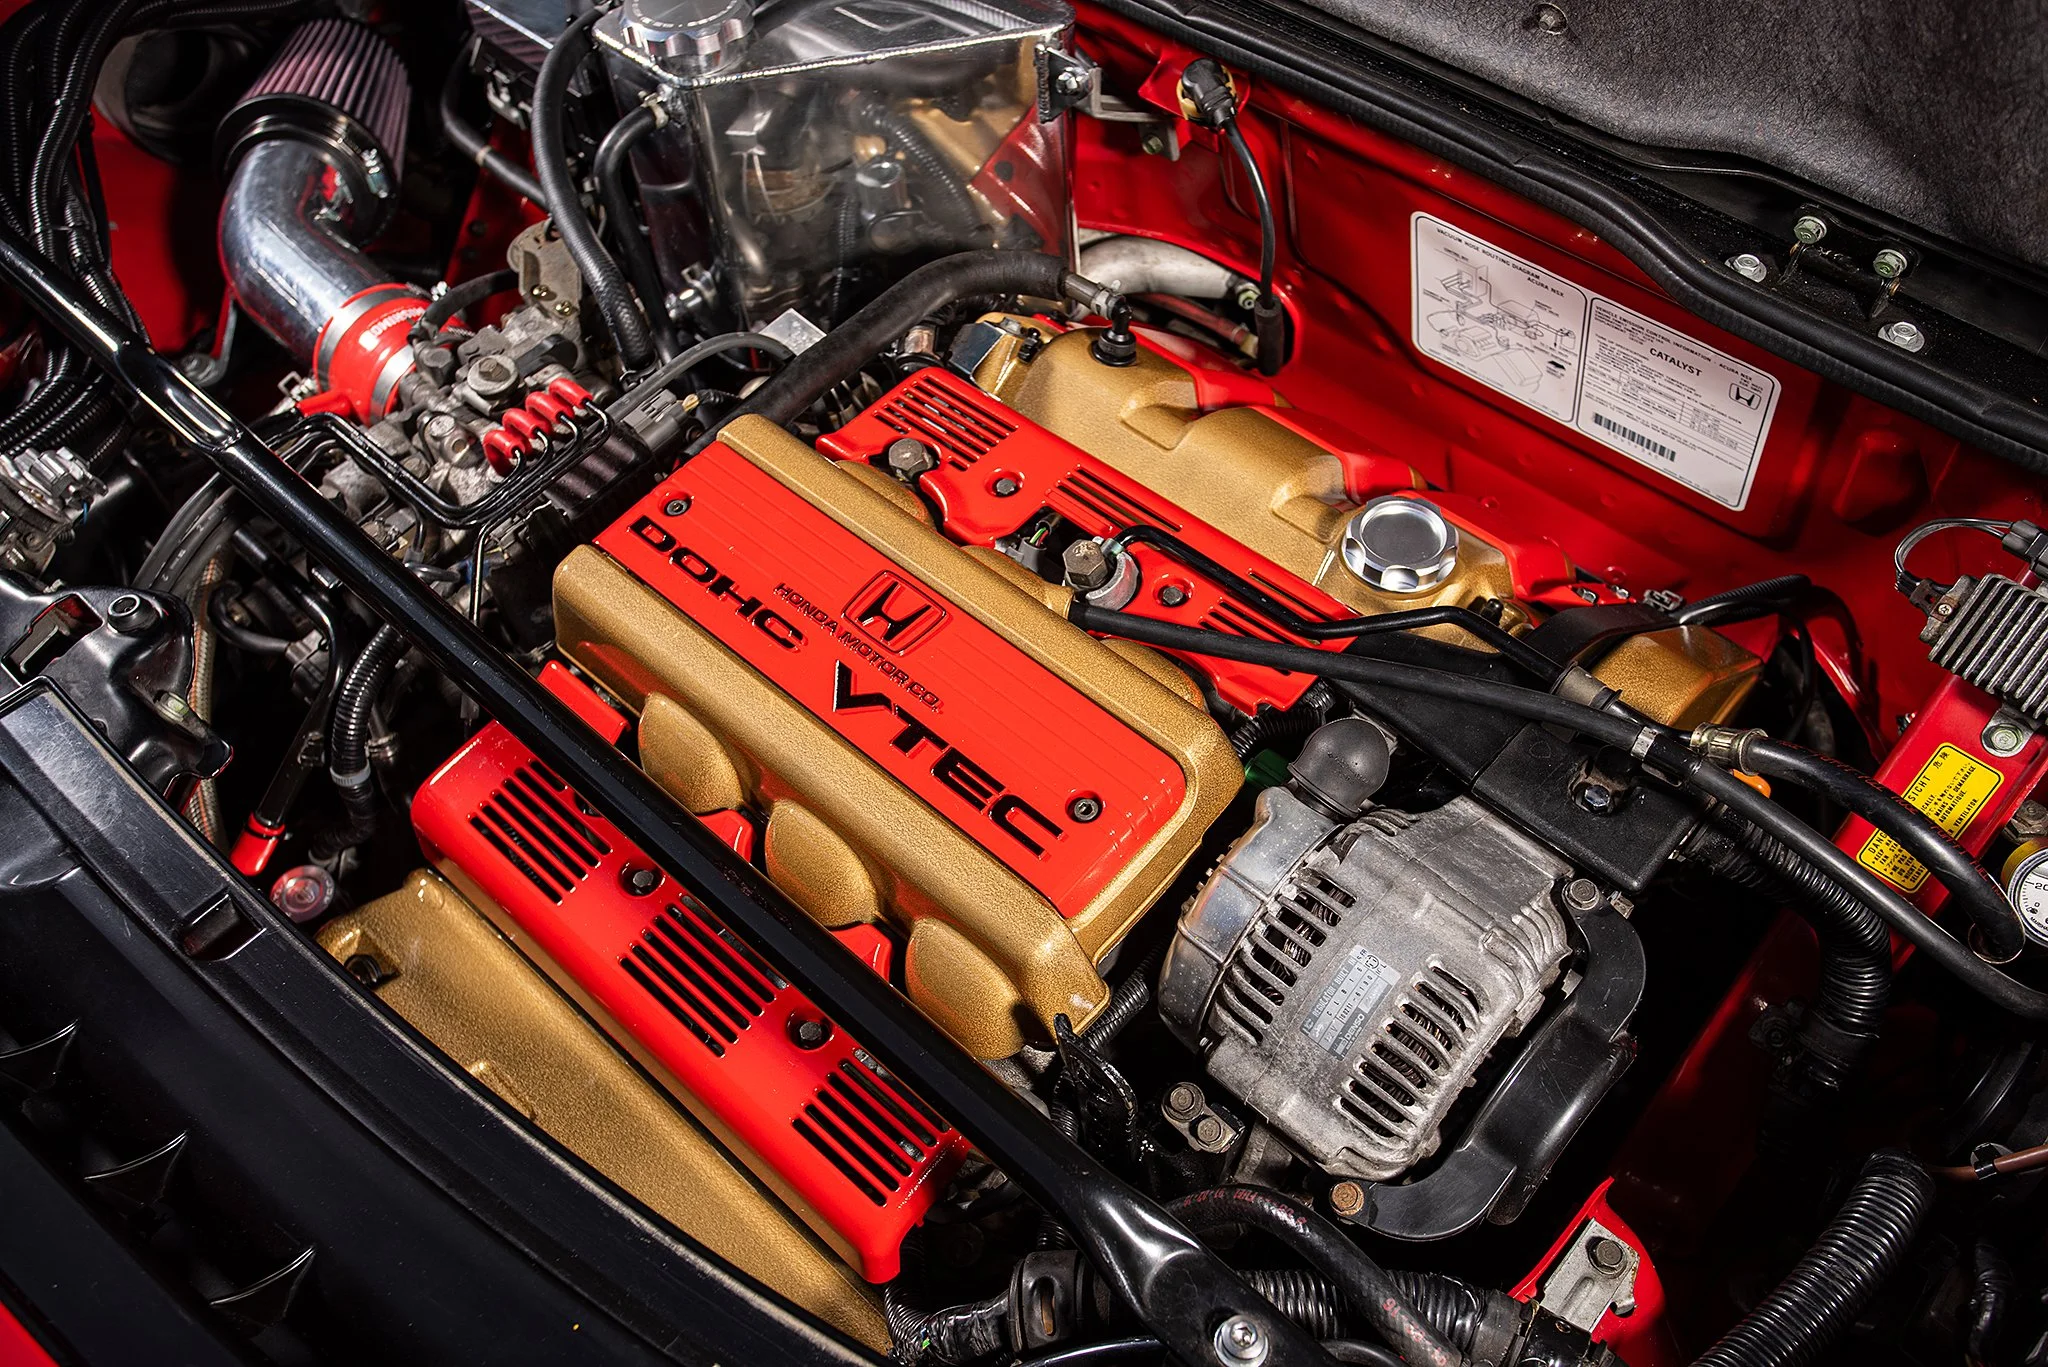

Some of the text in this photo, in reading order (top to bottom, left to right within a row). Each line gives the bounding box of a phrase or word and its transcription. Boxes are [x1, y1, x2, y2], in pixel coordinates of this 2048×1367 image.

[1511, 262, 1540, 280] DIAGRAM
[1526, 276, 1564, 298] ACURA NSX
[1648, 346, 1703, 378] CATALYST
[627, 516, 809, 653] DOHC
[773, 582, 838, 634] HONDA
[838, 629, 910, 686] MOTOR
[832, 659, 1066, 860] VTEC
[1866, 830, 1888, 854] DANG
[1906, 774, 1932, 802] SICHT
[1878, 854, 1889, 865] FAN
[1919, 792, 1937, 811] ICALLY.
[1896, 853, 1908, 864] PAS
[1933, 800, 1949, 817] MAINS
[1946, 792, 1954, 800] LE
[1951, 764, 1976, 793] DEMARRAGE
[1908, 864, 1926, 883] SELBST
[1952, 796, 1979, 827] VENTILATOR.
[1872, 848, 1885, 861] KEEP
[1902, 864, 1917, 879] NICHT
[1333, 966, 1349, 985] BUILT
[1343, 1012, 1366, 1040] DENSO
